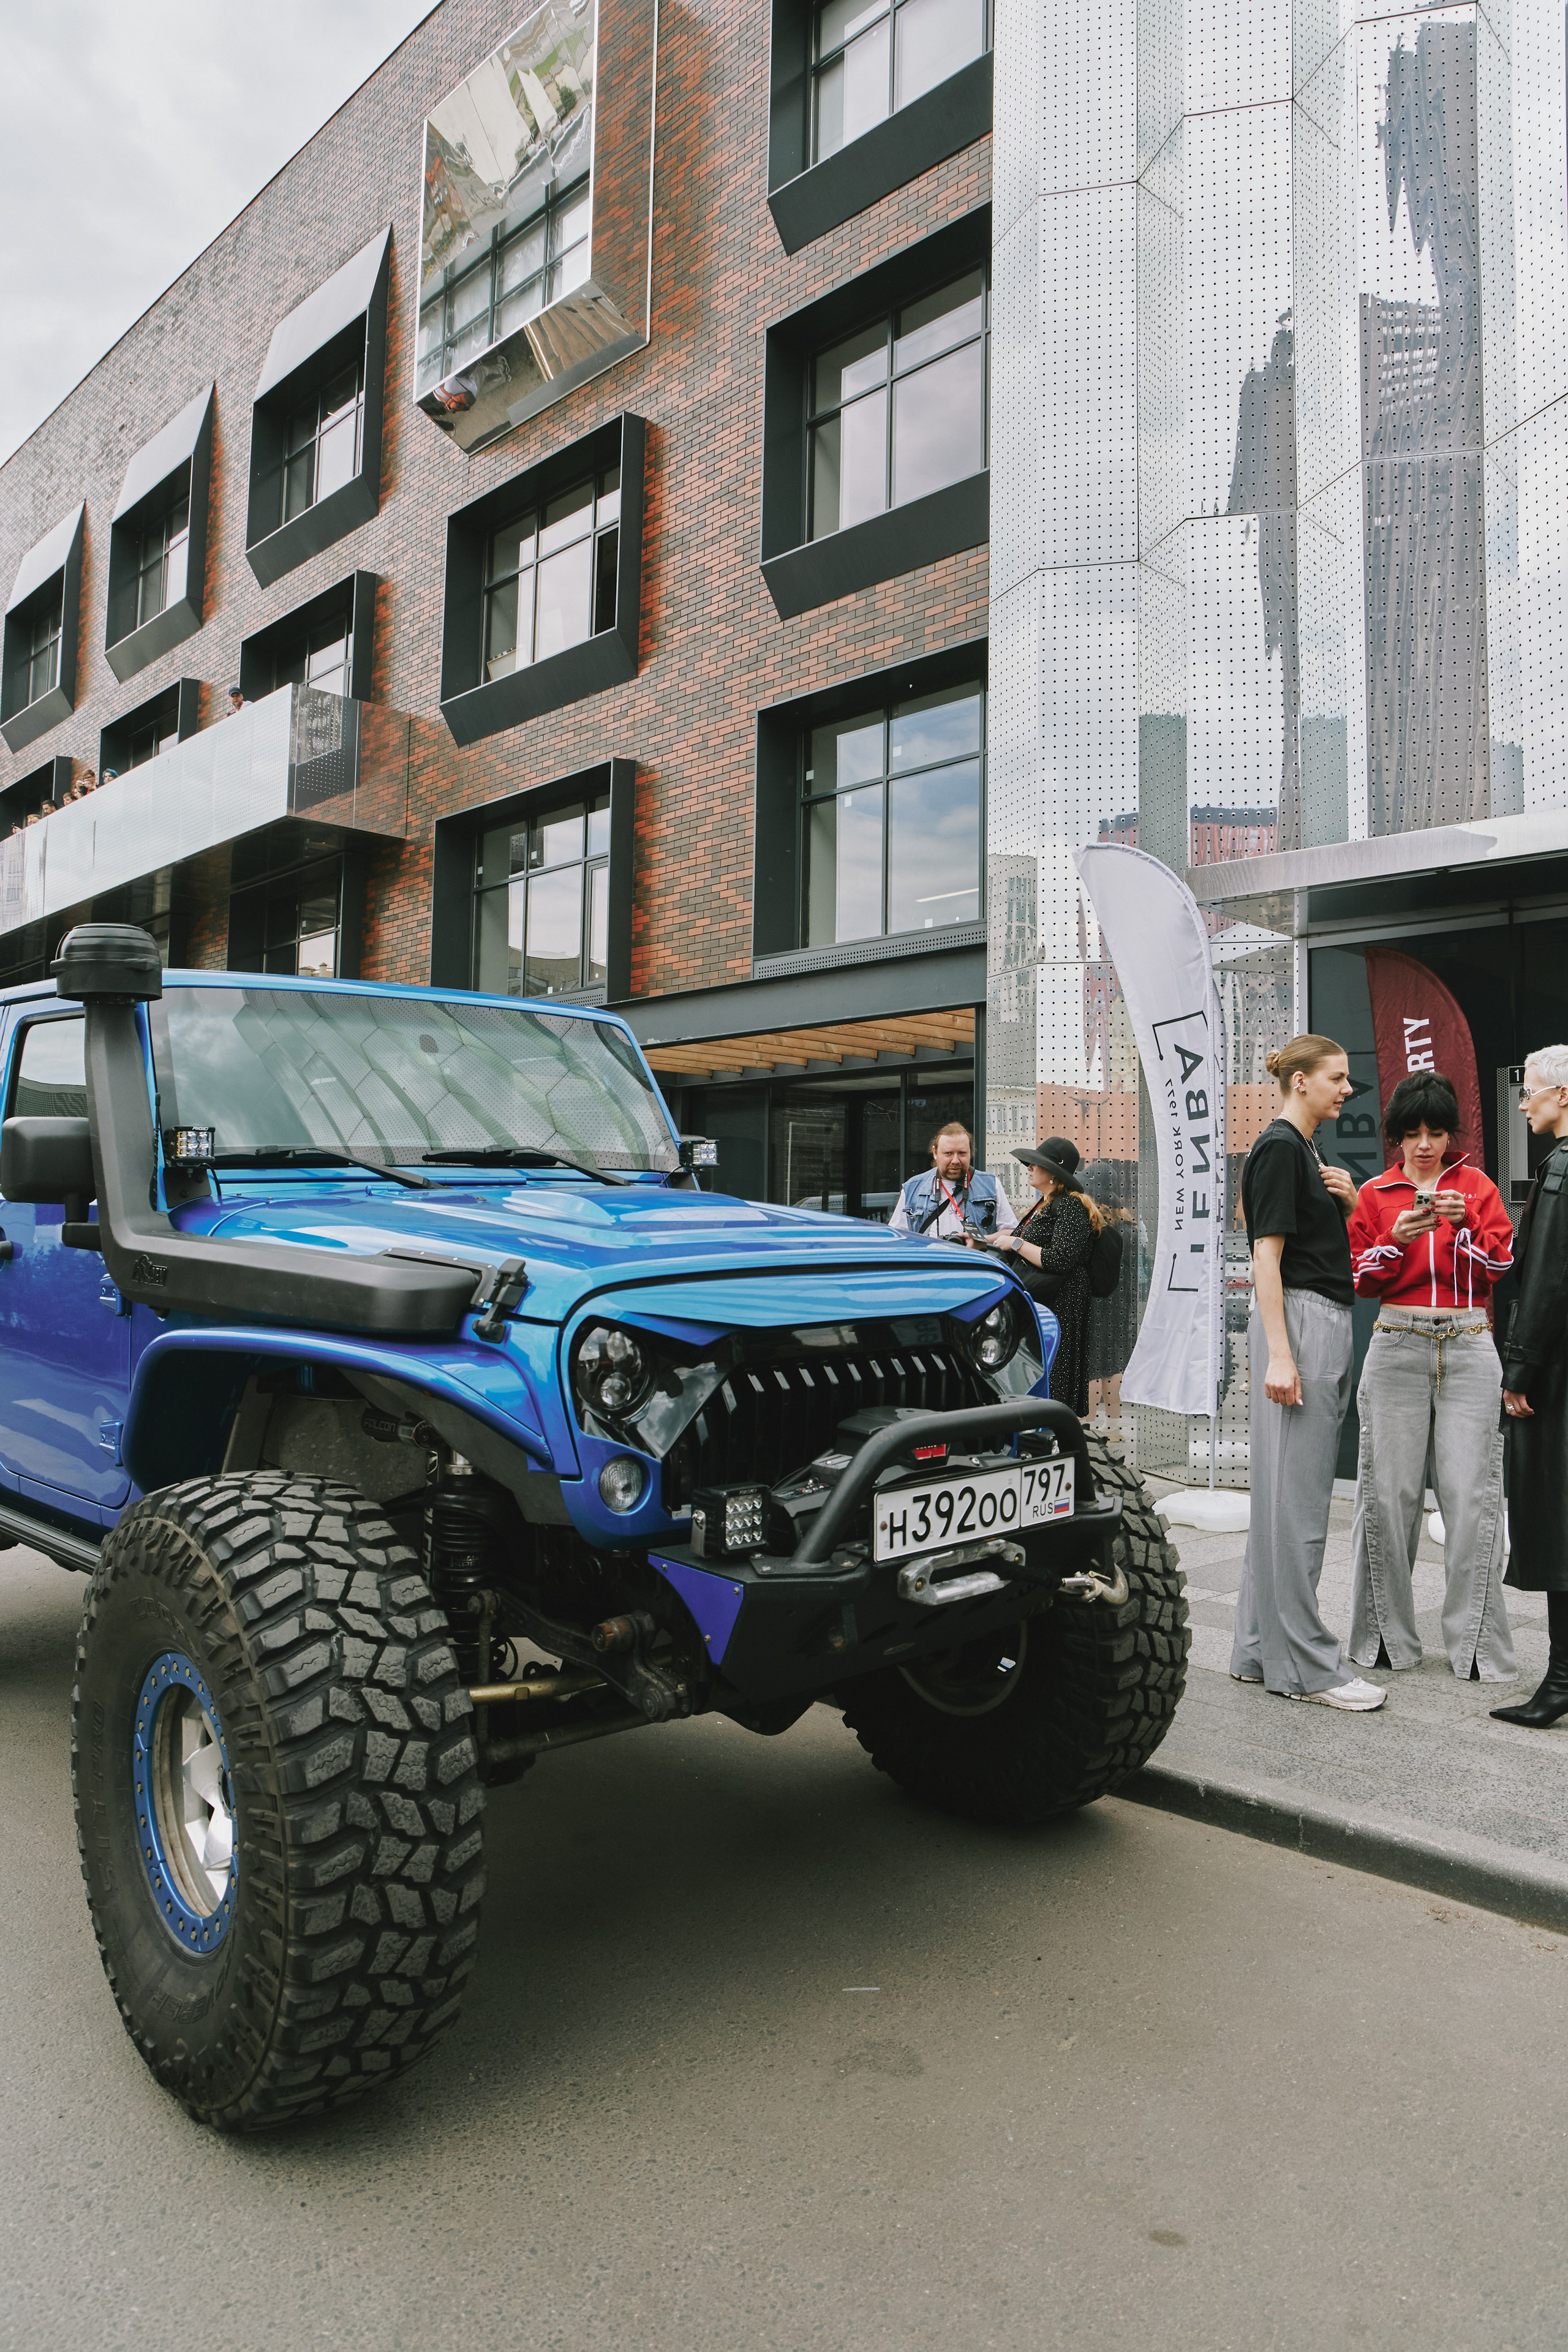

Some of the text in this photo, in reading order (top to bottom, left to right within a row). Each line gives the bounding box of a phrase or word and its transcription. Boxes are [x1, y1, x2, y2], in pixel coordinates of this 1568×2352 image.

[1403, 1017, 1435, 1072] RTY
[364, 1417, 397, 1433] FALCON
[1024, 1464, 1065, 1505] 797
[1033, 1502, 1054, 1518] RUS
